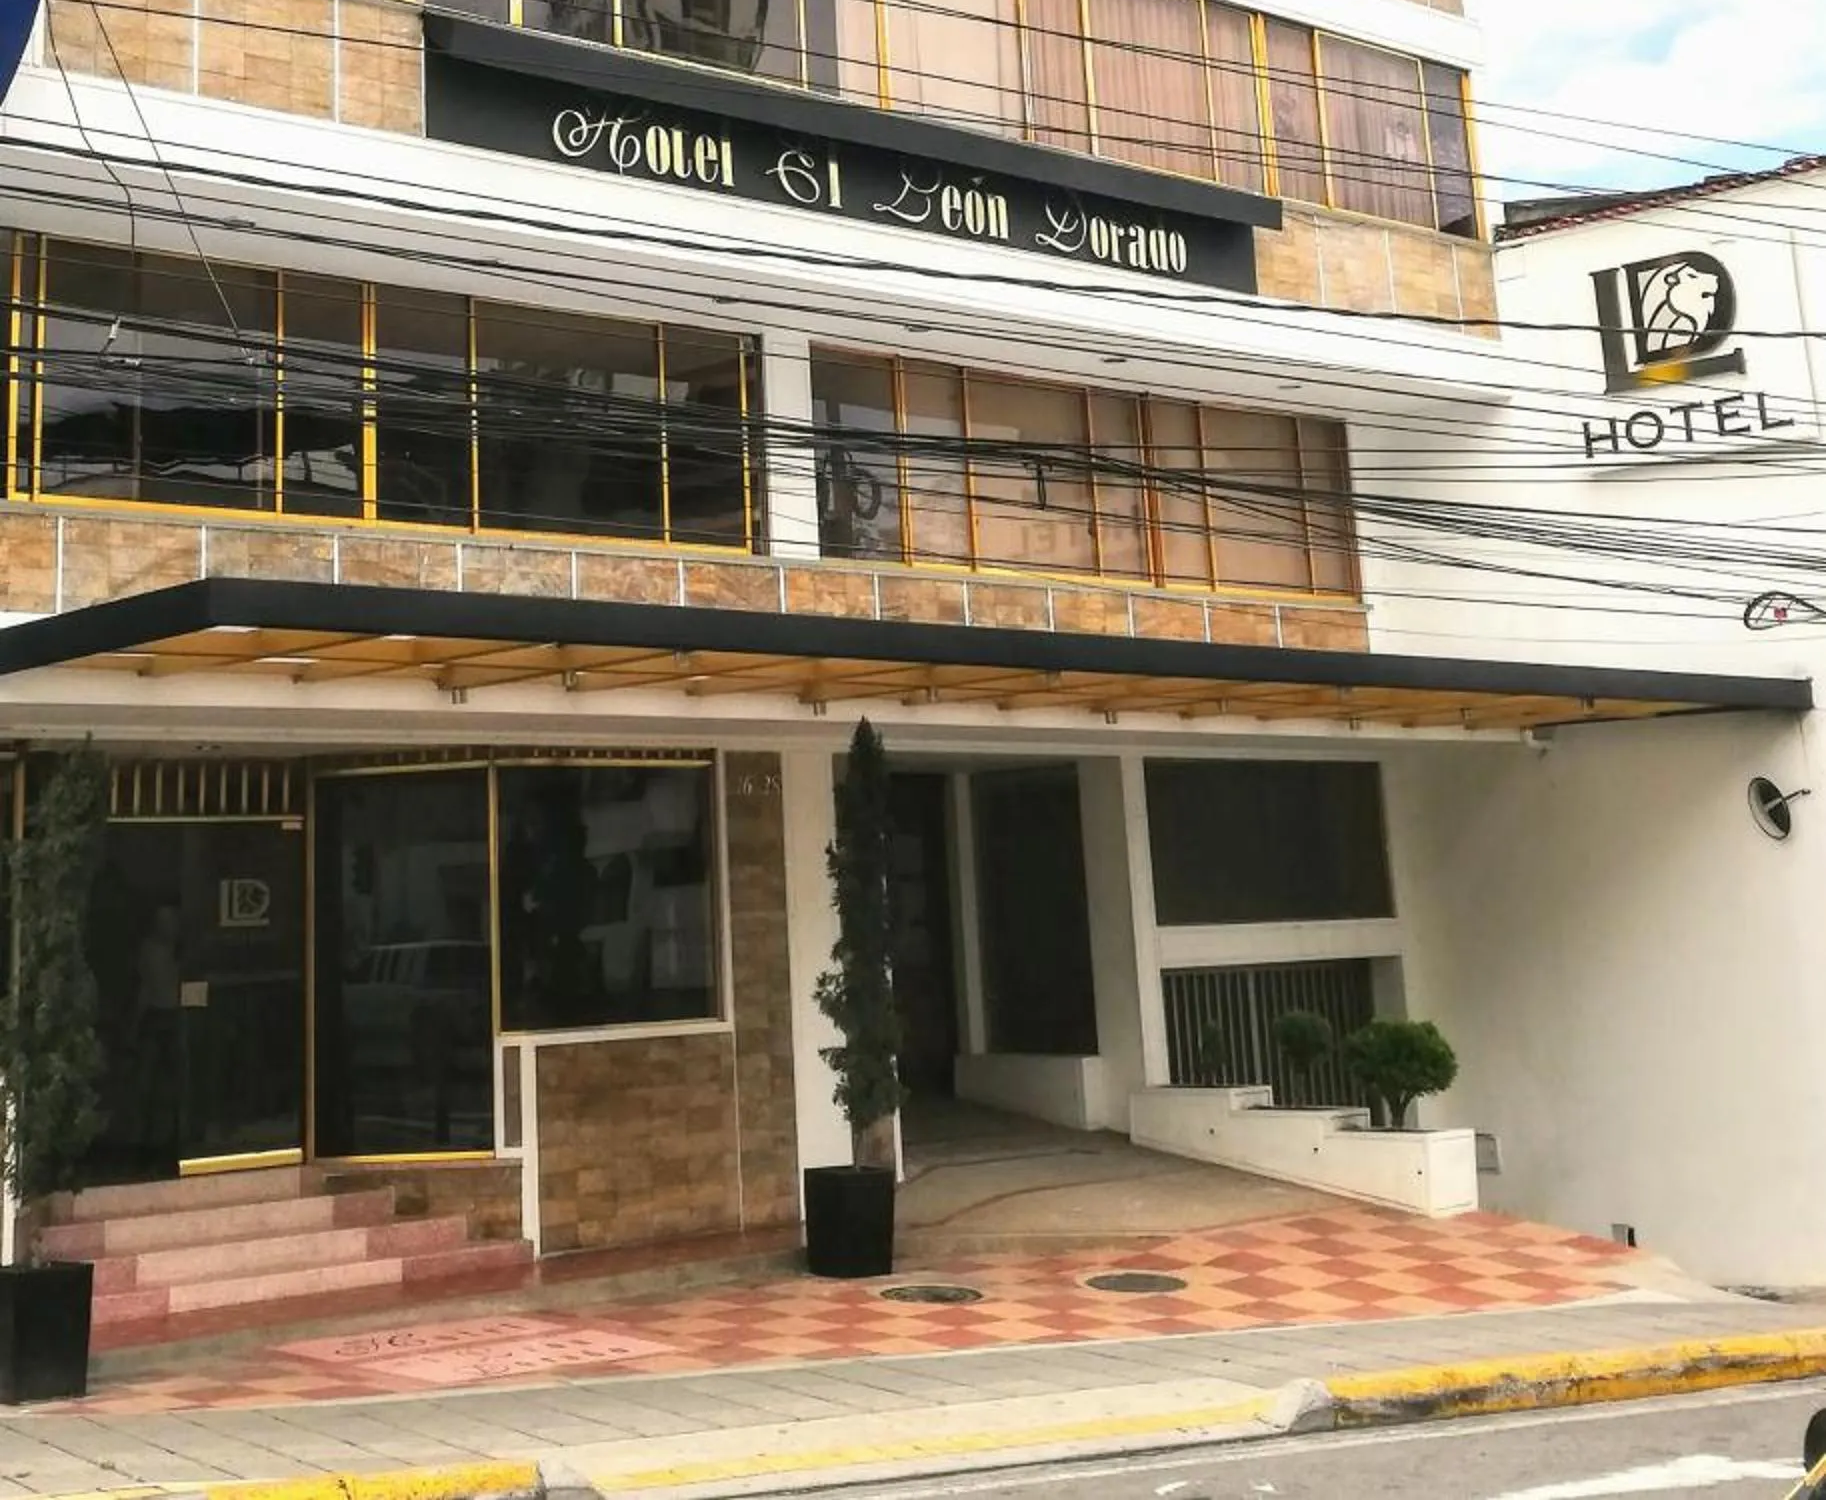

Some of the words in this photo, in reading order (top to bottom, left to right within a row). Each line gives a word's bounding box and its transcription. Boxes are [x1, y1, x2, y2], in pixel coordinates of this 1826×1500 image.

[552, 106, 735, 188] Hotel
[764, 147, 843, 209] El
[873, 167, 1009, 240] León
[1035, 192, 1188, 274] Dorado
[1582, 392, 1795, 459] HOTEL
